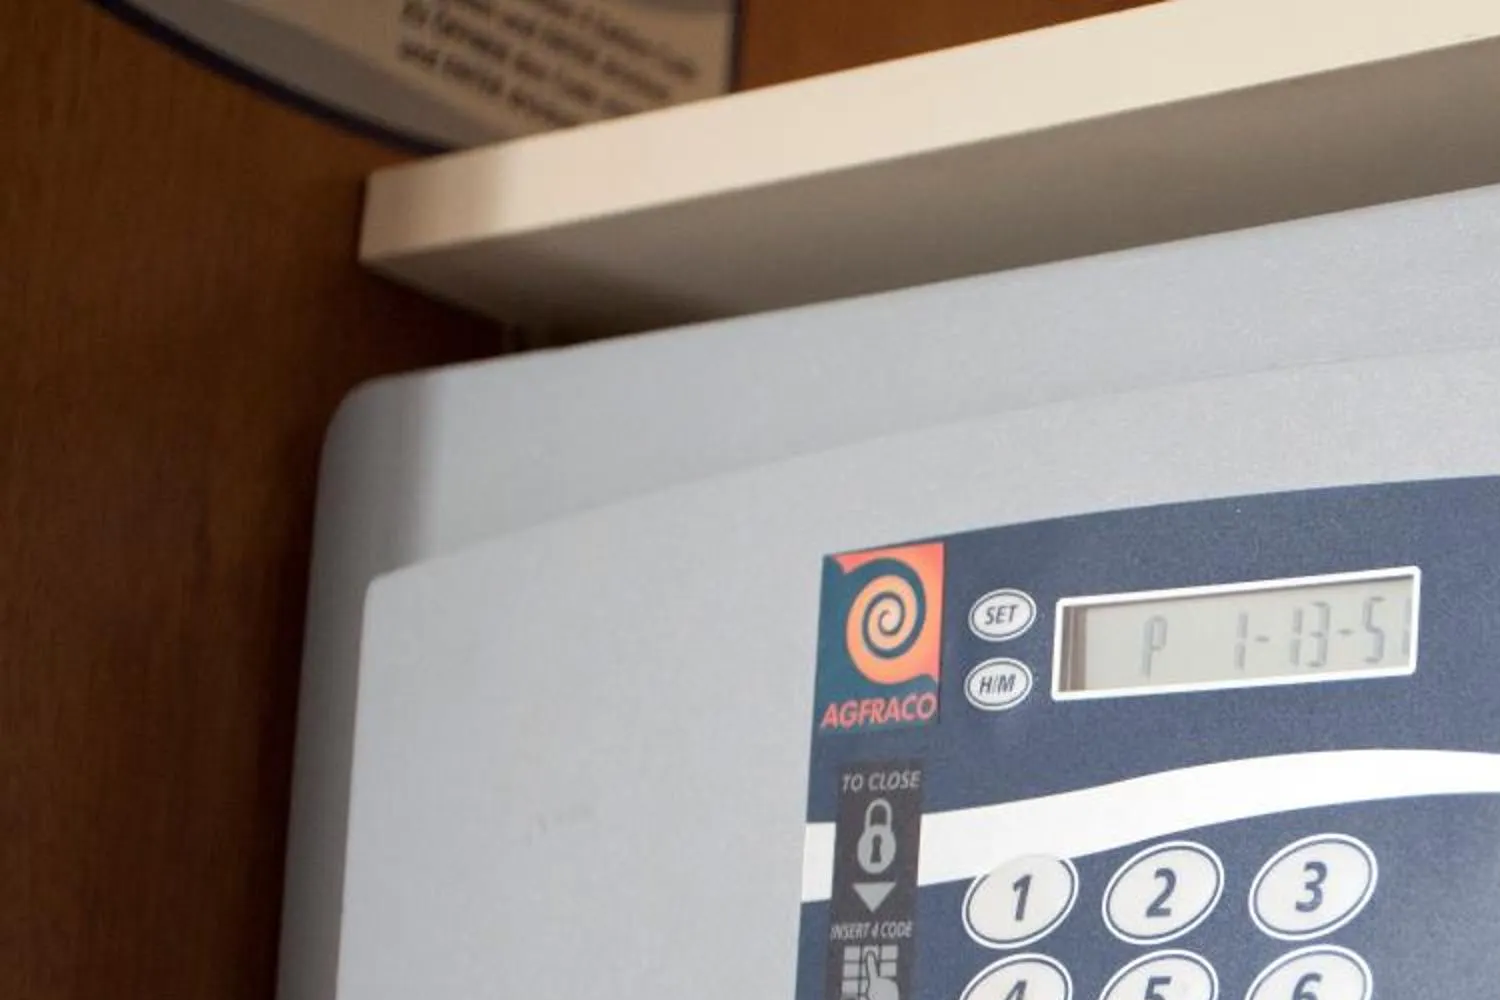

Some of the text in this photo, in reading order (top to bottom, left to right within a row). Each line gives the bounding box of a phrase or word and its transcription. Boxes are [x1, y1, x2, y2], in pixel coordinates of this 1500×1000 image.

[984, 604, 1019, 626] SET
[1138, 614, 1169, 679] P
[978, 673, 1017, 695] H/M
[820, 692, 938, 728] AGFRACO
[842, 769, 922, 793] TO CLOSE
[1012, 873, 1033, 922] 1
[1144, 867, 1177, 919] 2
[1294, 860, 1328, 914] 3
[880, 919, 913, 939] CODE
